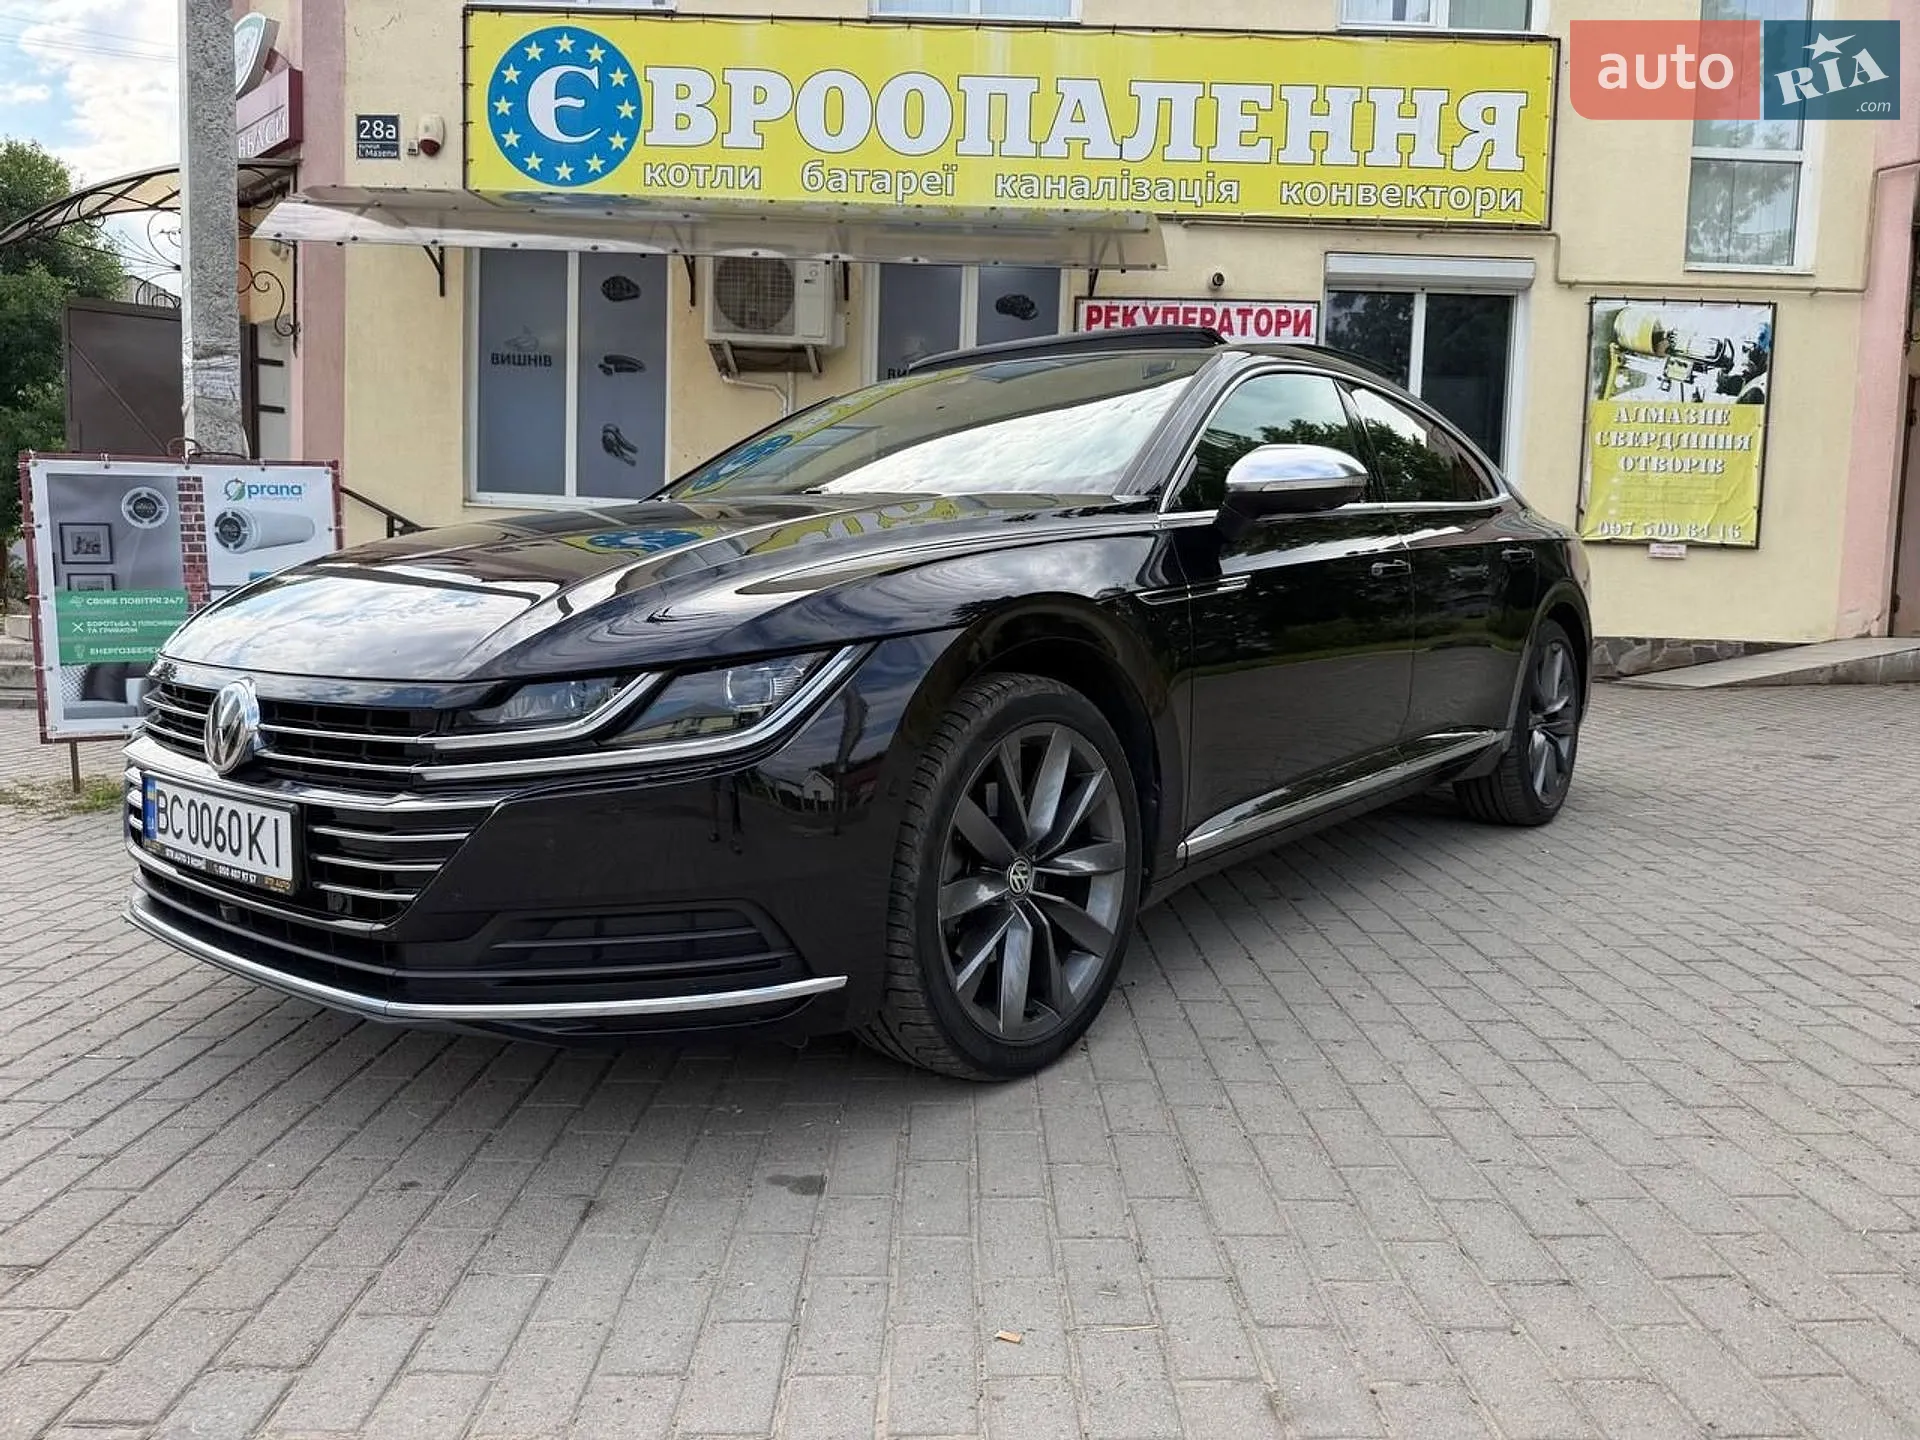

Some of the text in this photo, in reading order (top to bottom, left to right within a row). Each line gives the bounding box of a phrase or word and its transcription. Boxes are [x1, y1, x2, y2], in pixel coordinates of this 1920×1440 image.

[359, 119, 396, 139] 28а
[643, 159, 1524, 217] котли батареї каналізація конвектори
[247, 484, 303, 499] prana
